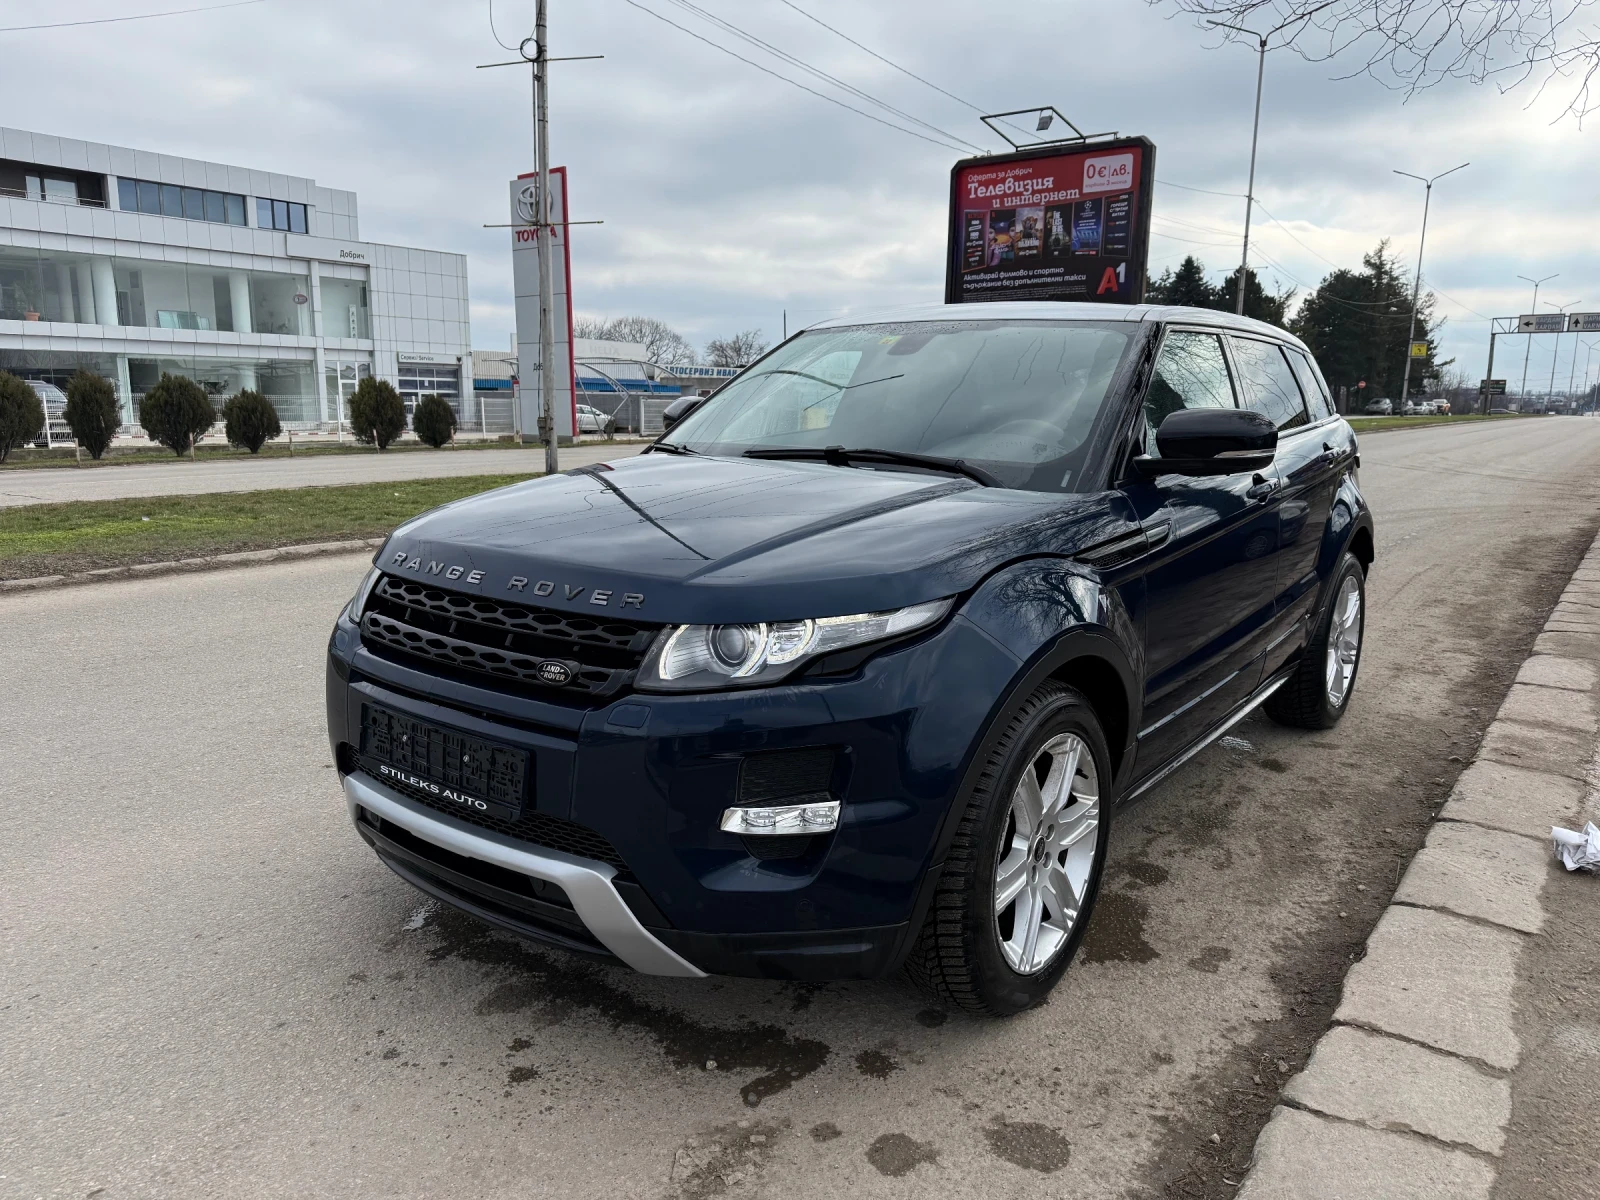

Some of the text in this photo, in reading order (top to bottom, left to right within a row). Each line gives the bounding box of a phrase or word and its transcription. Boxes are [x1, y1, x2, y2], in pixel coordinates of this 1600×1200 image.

[968, 167, 1033, 182] Оферта за Добрич
[968, 177, 1054, 199] Телевизия
[992, 189, 1080, 208] и интернет
[515, 226, 557, 242] TOYA
[339, 249, 365, 260] Добрич
[963, 271, 999, 282] Активирай
[999, 268, 1028, 279] филмово
[1034, 267, 1065, 276] спортно
[963, 274, 1086, 290] съдържание без допълнителни такси
[1096, 262, 1126, 294] A1
[716, 368, 737, 377] ИВАН
[391, 551, 645, 610] RANGE ROVER
[543, 664, 560, 673] LAND
[543, 671, 566, 681] ROVER
[379, 764, 488, 811] STILEKS AUTO
